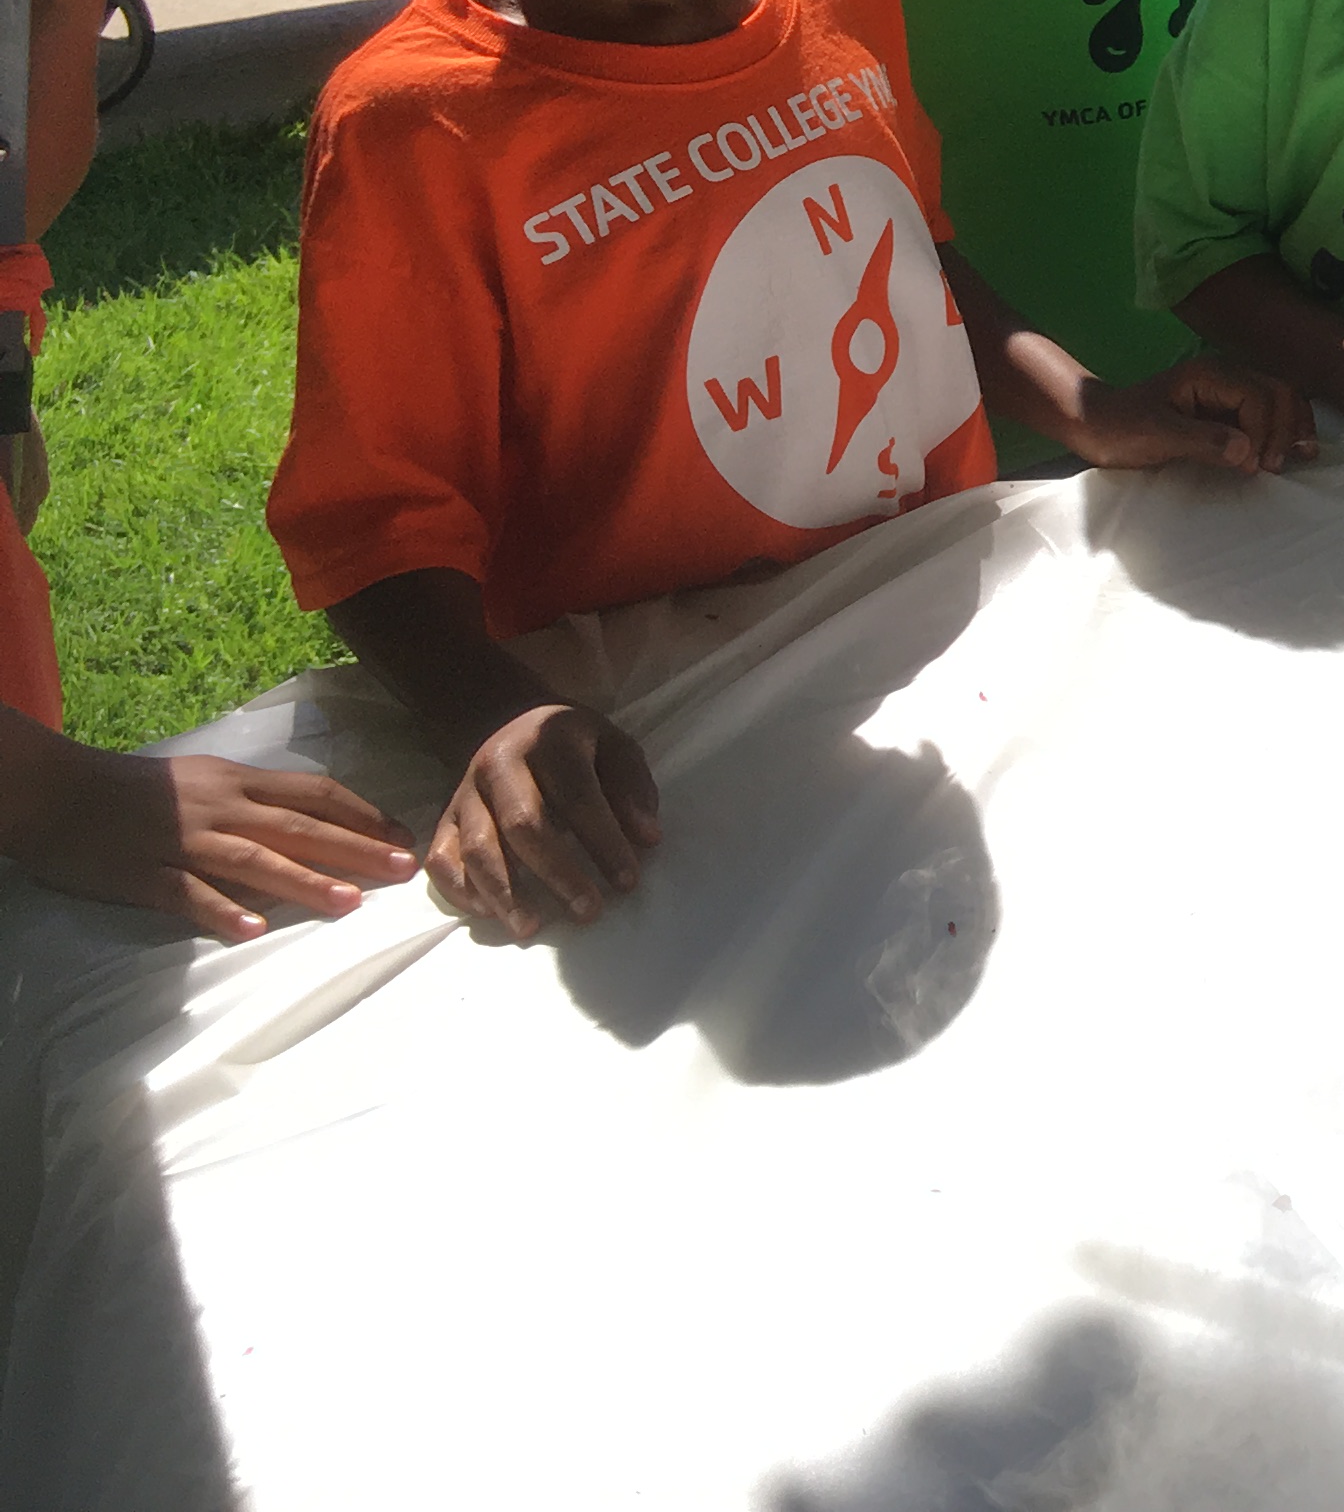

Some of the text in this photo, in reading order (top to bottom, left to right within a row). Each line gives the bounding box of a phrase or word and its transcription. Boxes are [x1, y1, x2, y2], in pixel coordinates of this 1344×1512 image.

[1042, 99, 1147, 127] YMCA OF
[523, 151, 693, 266] STATE
[688, 76, 864, 183] COLLEGE
[803, 183, 855, 256] N
[704, 355, 782, 432] W
